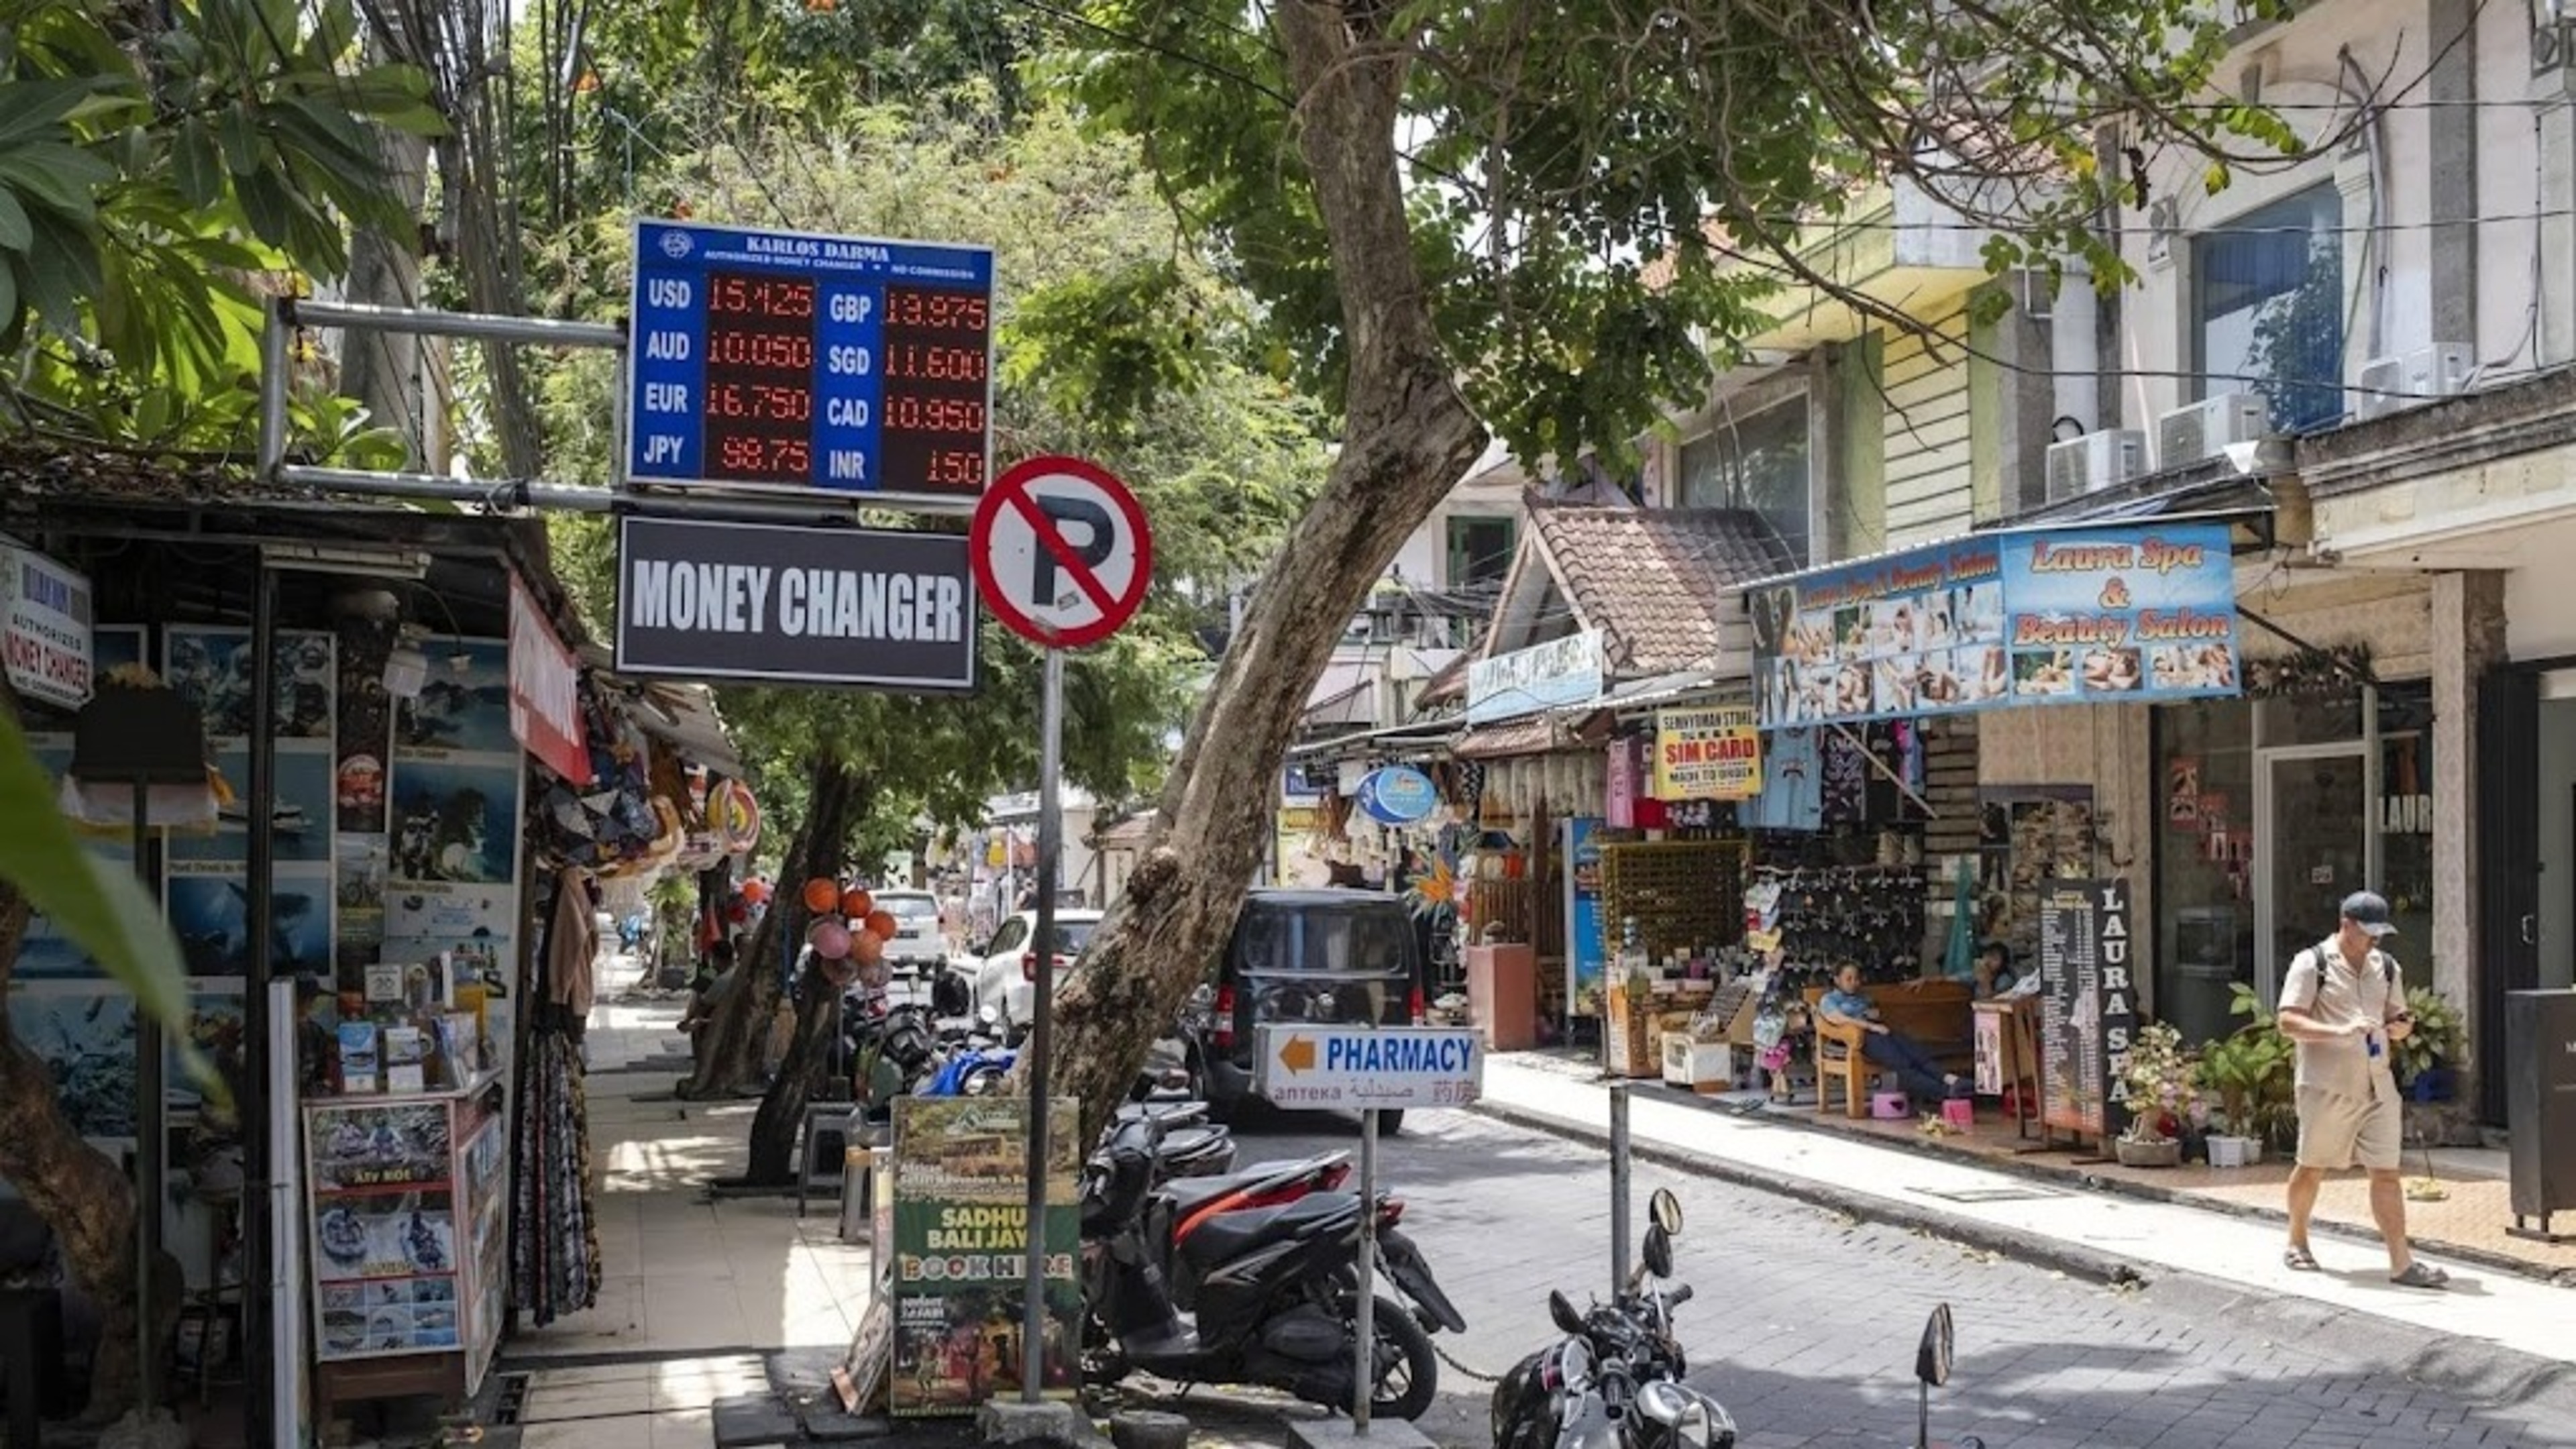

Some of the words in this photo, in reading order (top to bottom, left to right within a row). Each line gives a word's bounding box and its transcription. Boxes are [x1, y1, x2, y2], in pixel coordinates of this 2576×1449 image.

[746, 237, 818, 257] KARLOS
[824, 243, 890, 262] DARMA
[813, 258, 864, 270] CHANGER
[648, 278, 692, 309] USD
[829, 293, 871, 323] GBP
[646, 331, 690, 360] AUD
[708, 331, 811, 368] 10.050
[828, 344, 871, 376] SGD
[645, 382, 688, 413] EUR
[706, 383, 810, 421] 16.750
[827, 396, 869, 427] CAD
[643, 435, 684, 464] JPY
[829, 449, 865, 480] INR
[927, 449, 982, 484] 150
[2031, 539, 2133, 573] Laura
[2138, 537, 2203, 576] Spa
[631, 559, 770, 634] MONEY
[778, 568, 963, 642] CHANGER
[2099, 577, 2131, 608] &
[2013, 613, 2130, 650] Beauty
[2133, 606, 2230, 639] Salon
[1665, 741, 1701, 765] SIM
[1705, 737, 1754, 761] CARD
[2102, 888, 2129, 1015] LAURA
[1327, 1037, 1474, 1073] PHARMACY
[1275, 1083, 1342, 1102] аптека
[1350, 1076, 1414, 1104] صيدلية
[941, 1208, 1027, 1228] SADHU
[928, 1229, 982, 1249] BALI
[985, 1228, 1028, 1249] JAY
[902, 1254, 992, 1281] BOOK
